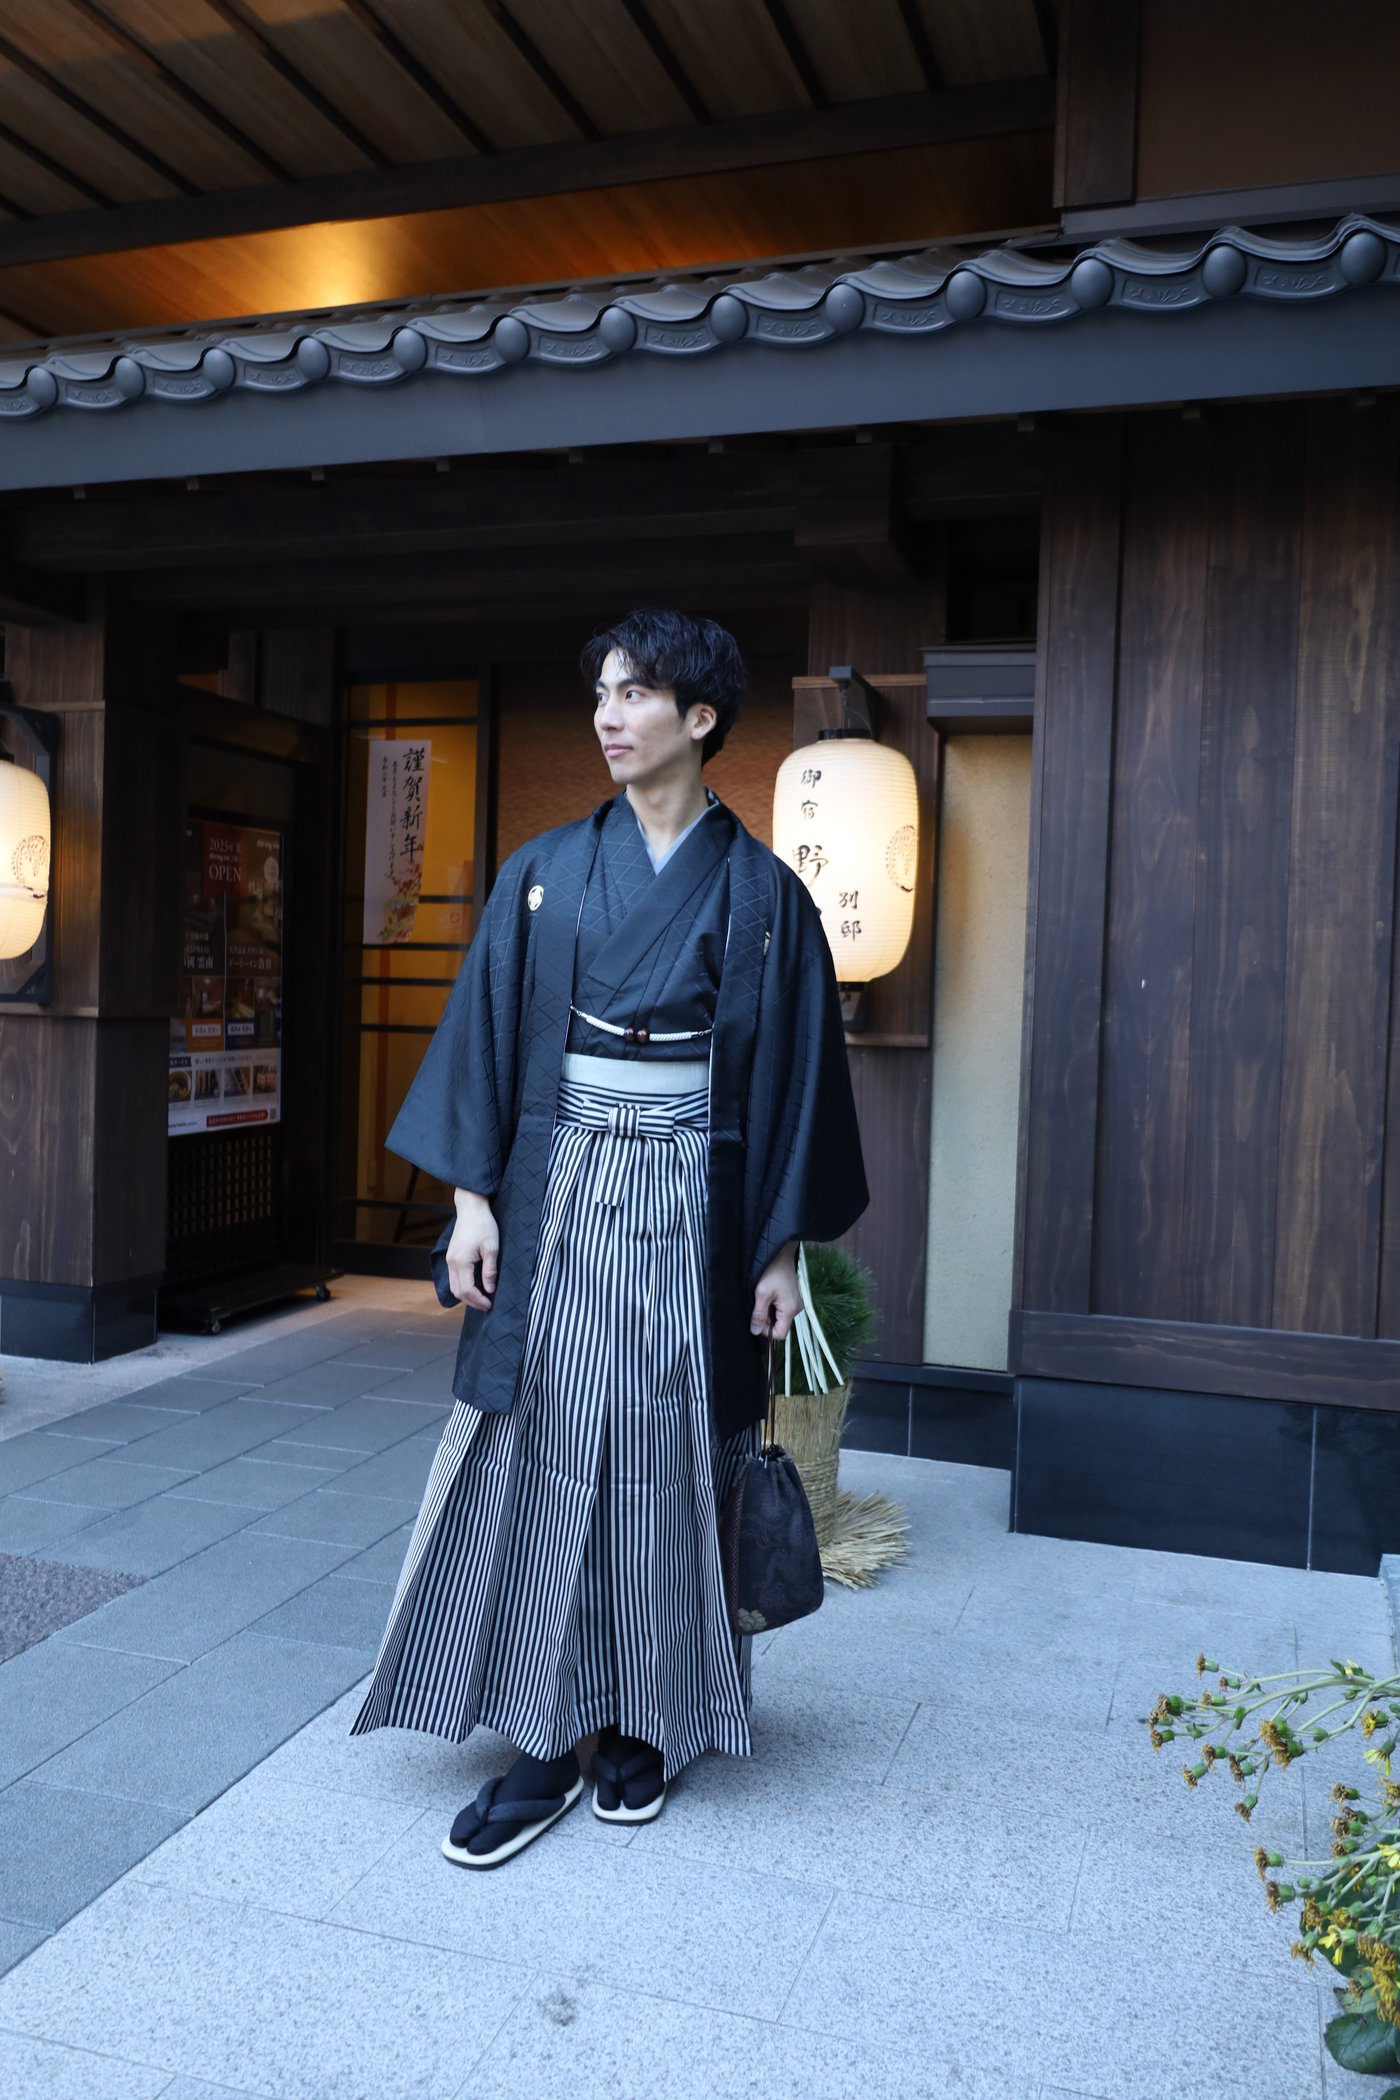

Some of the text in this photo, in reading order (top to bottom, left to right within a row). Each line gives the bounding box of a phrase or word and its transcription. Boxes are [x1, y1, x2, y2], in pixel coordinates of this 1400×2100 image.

[400, 747, 425, 864] 謹賀新年
[208, 863, 241, 882] OPEN
[838, 890, 862, 942] 別邸
